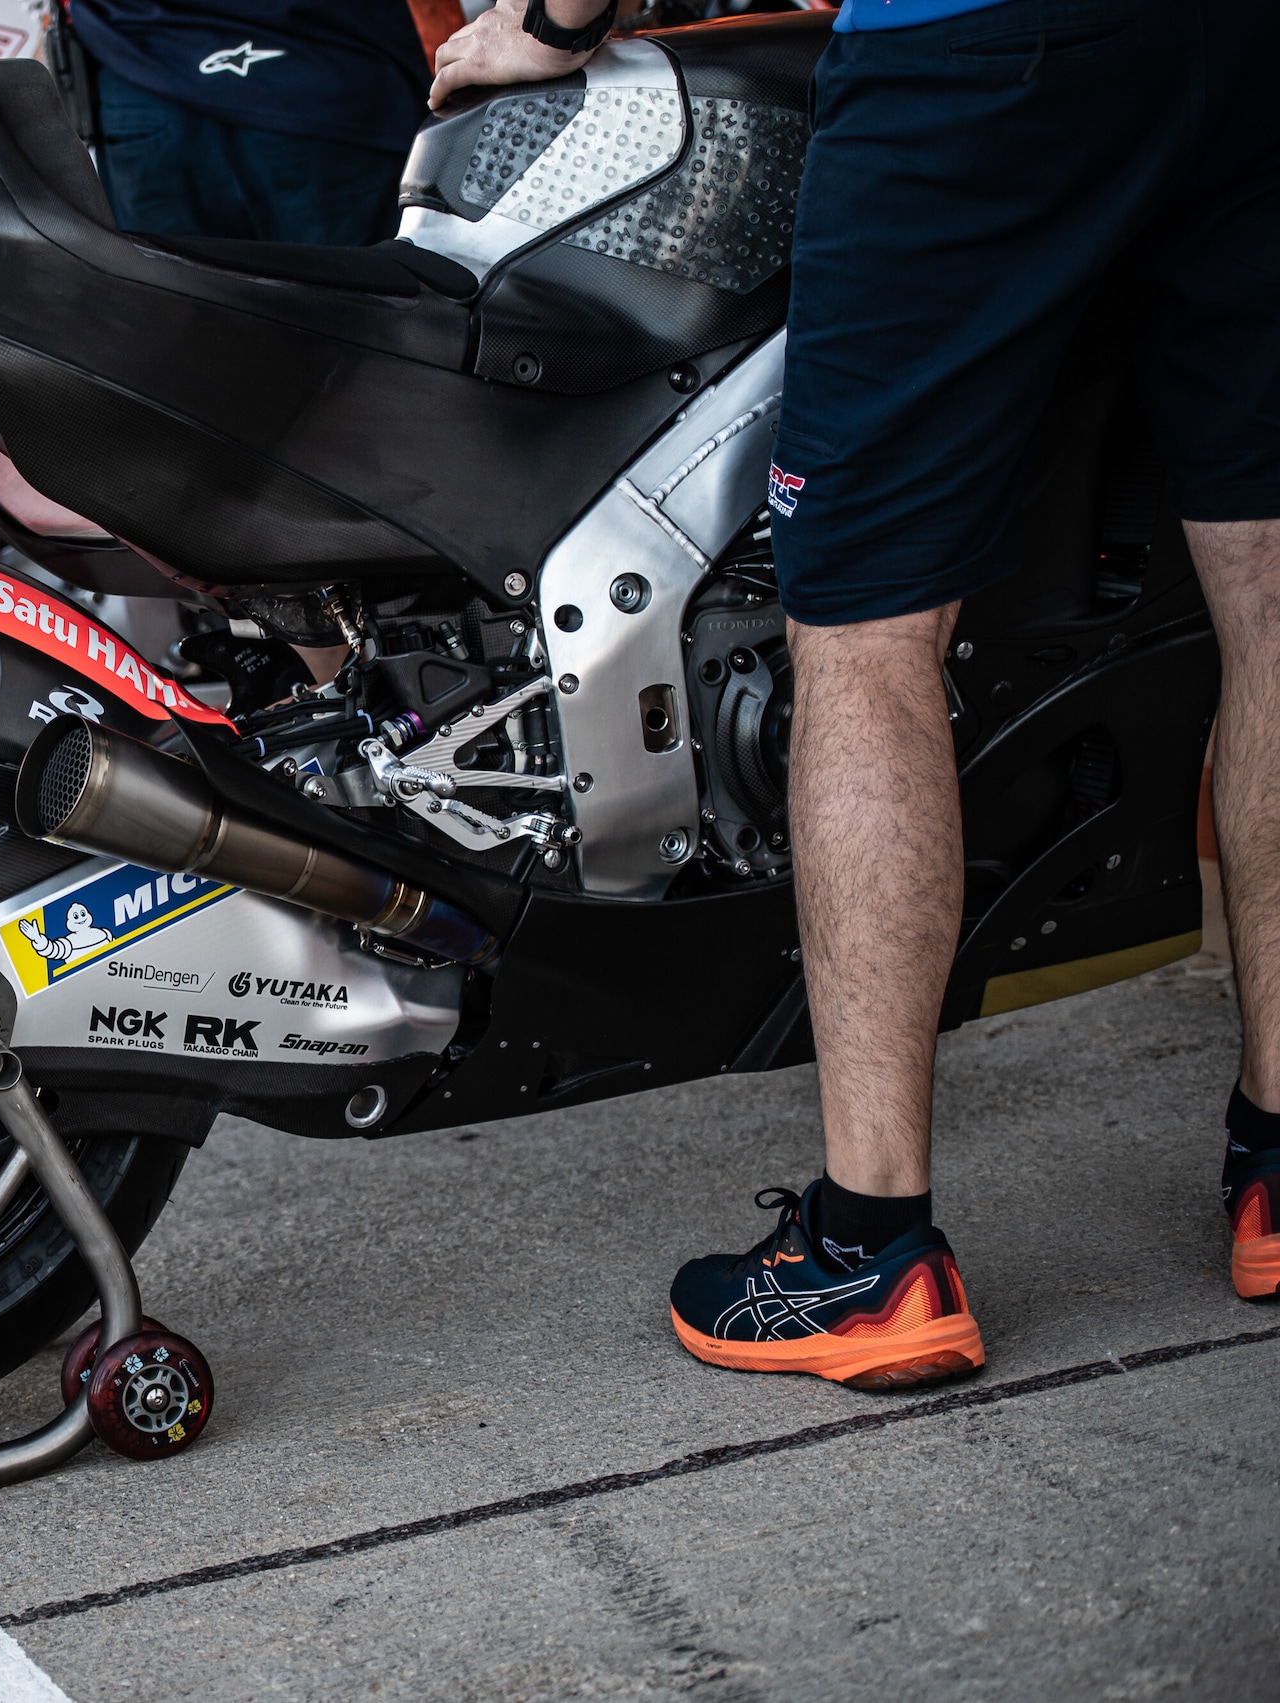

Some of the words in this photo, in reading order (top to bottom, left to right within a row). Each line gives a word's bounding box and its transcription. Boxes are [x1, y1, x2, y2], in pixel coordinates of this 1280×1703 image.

[707, 617, 777, 632] HONDA
[113, 872, 209, 928] MIC
[107, 960, 200, 988] ShinDengen
[255, 977, 349, 1004] YUTAKA
[279, 998, 300, 1006] Clean
[300, 1000, 312, 1008] for
[312, 1001, 324, 1009] the
[324, 1002, 348, 1011] Future
[89, 1005, 168, 1040] NGK
[183, 1014, 262, 1051] RK
[88, 1035, 124, 1046] SPARK
[127, 1039, 164, 1050] PLUGS
[183, 1043, 230, 1055] TAKASAGO
[232, 1048, 259, 1058] CHAIN
[278, 1033, 369, 1056] Snap-on
